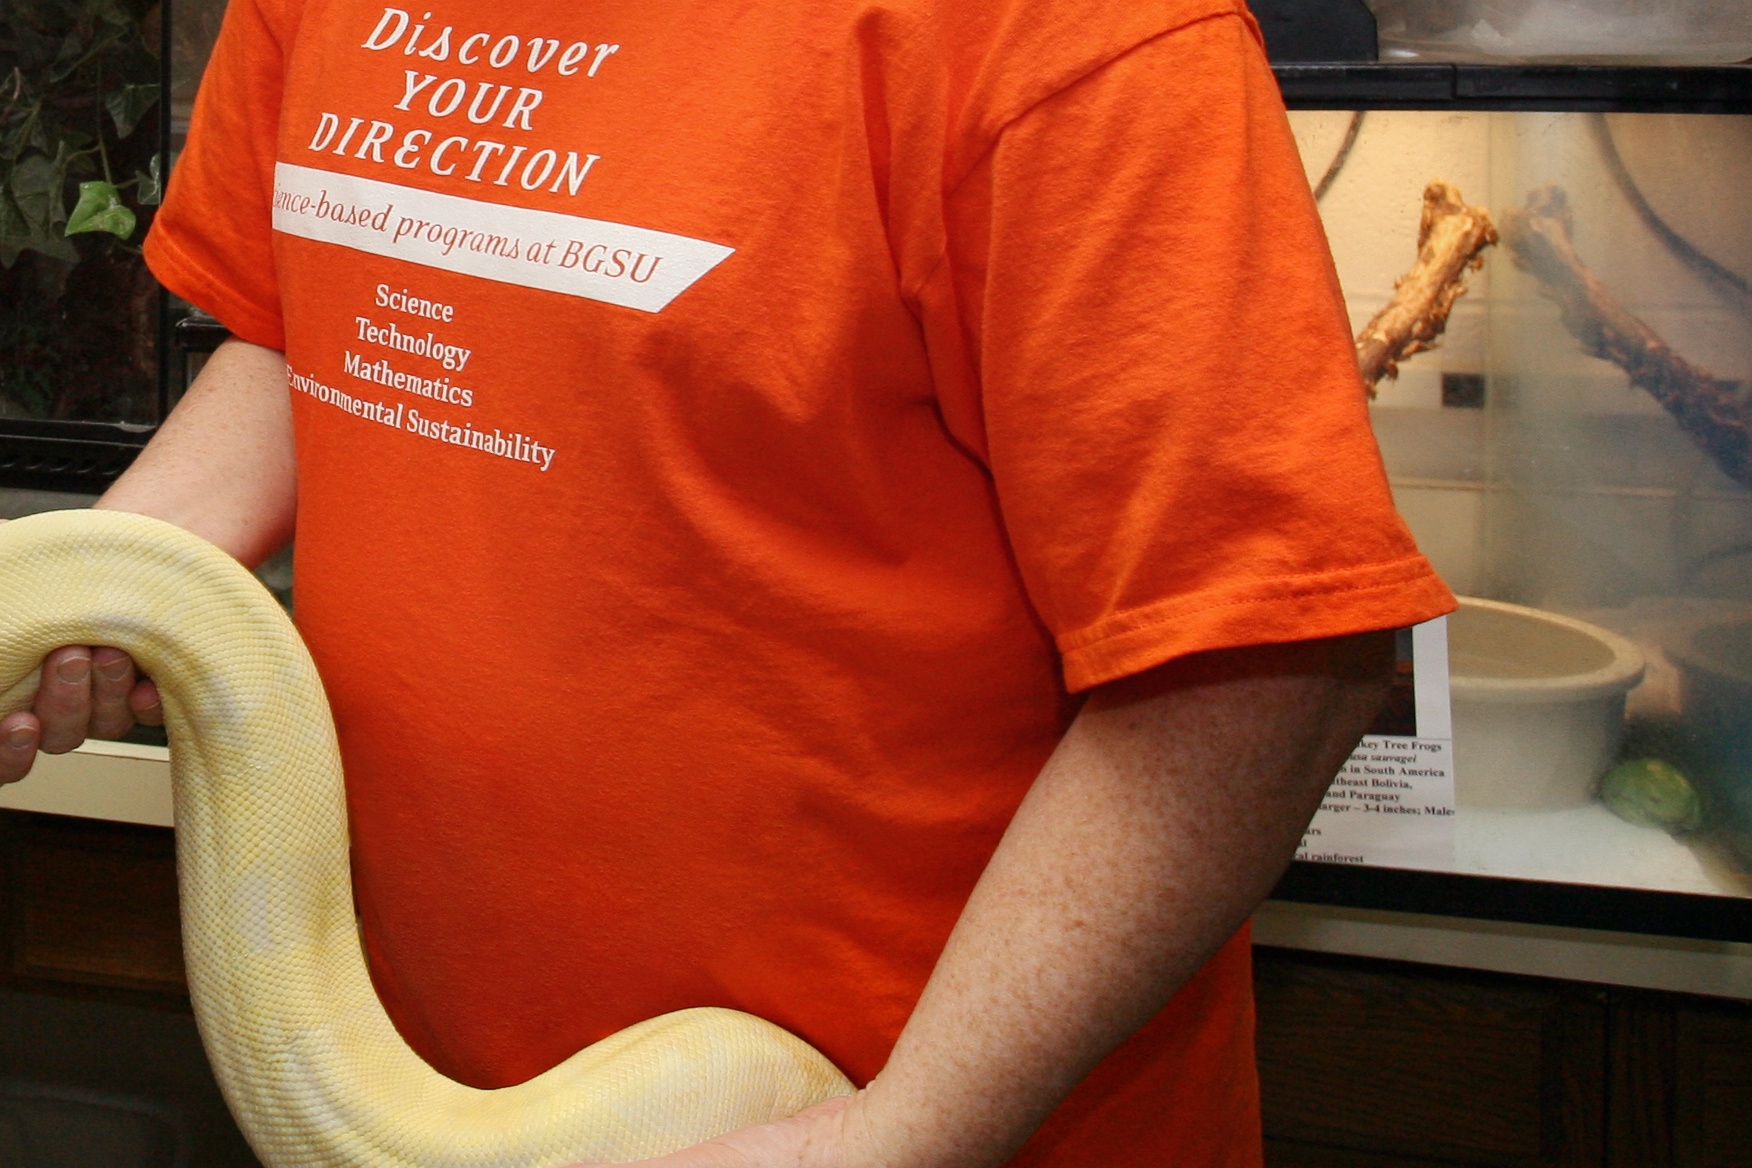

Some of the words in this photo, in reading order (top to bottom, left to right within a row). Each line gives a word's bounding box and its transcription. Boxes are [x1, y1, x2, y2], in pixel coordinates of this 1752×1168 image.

[361, 6, 621, 78] Discover
[393, 69, 545, 132] YOUR
[307, 111, 602, 198] DIRECTION
[391, 214, 521, 259] programs
[526, 238, 557, 266] at
[557, 239, 665, 286] BGSU
[374, 283, 455, 323] Science
[355, 315, 472, 372] Technology
[343, 349, 474, 408] Mathematics
[286, 363, 405, 430] Environmental
[405, 408, 557, 472] Sustainability
[1383, 740, 1409, 751] Tree
[1411, 740, 1442, 753] Frogs
[1350, 765, 1361, 774] in
[1364, 765, 1395, 775] South
[1399, 767, 1445, 778] America
[1371, 778, 1413, 790] Bolivia,
[1349, 791, 1401, 802] Paraguay
[1383, 804, 1421, 816] inches;
[1311, 854, 1364, 865] rainforest
